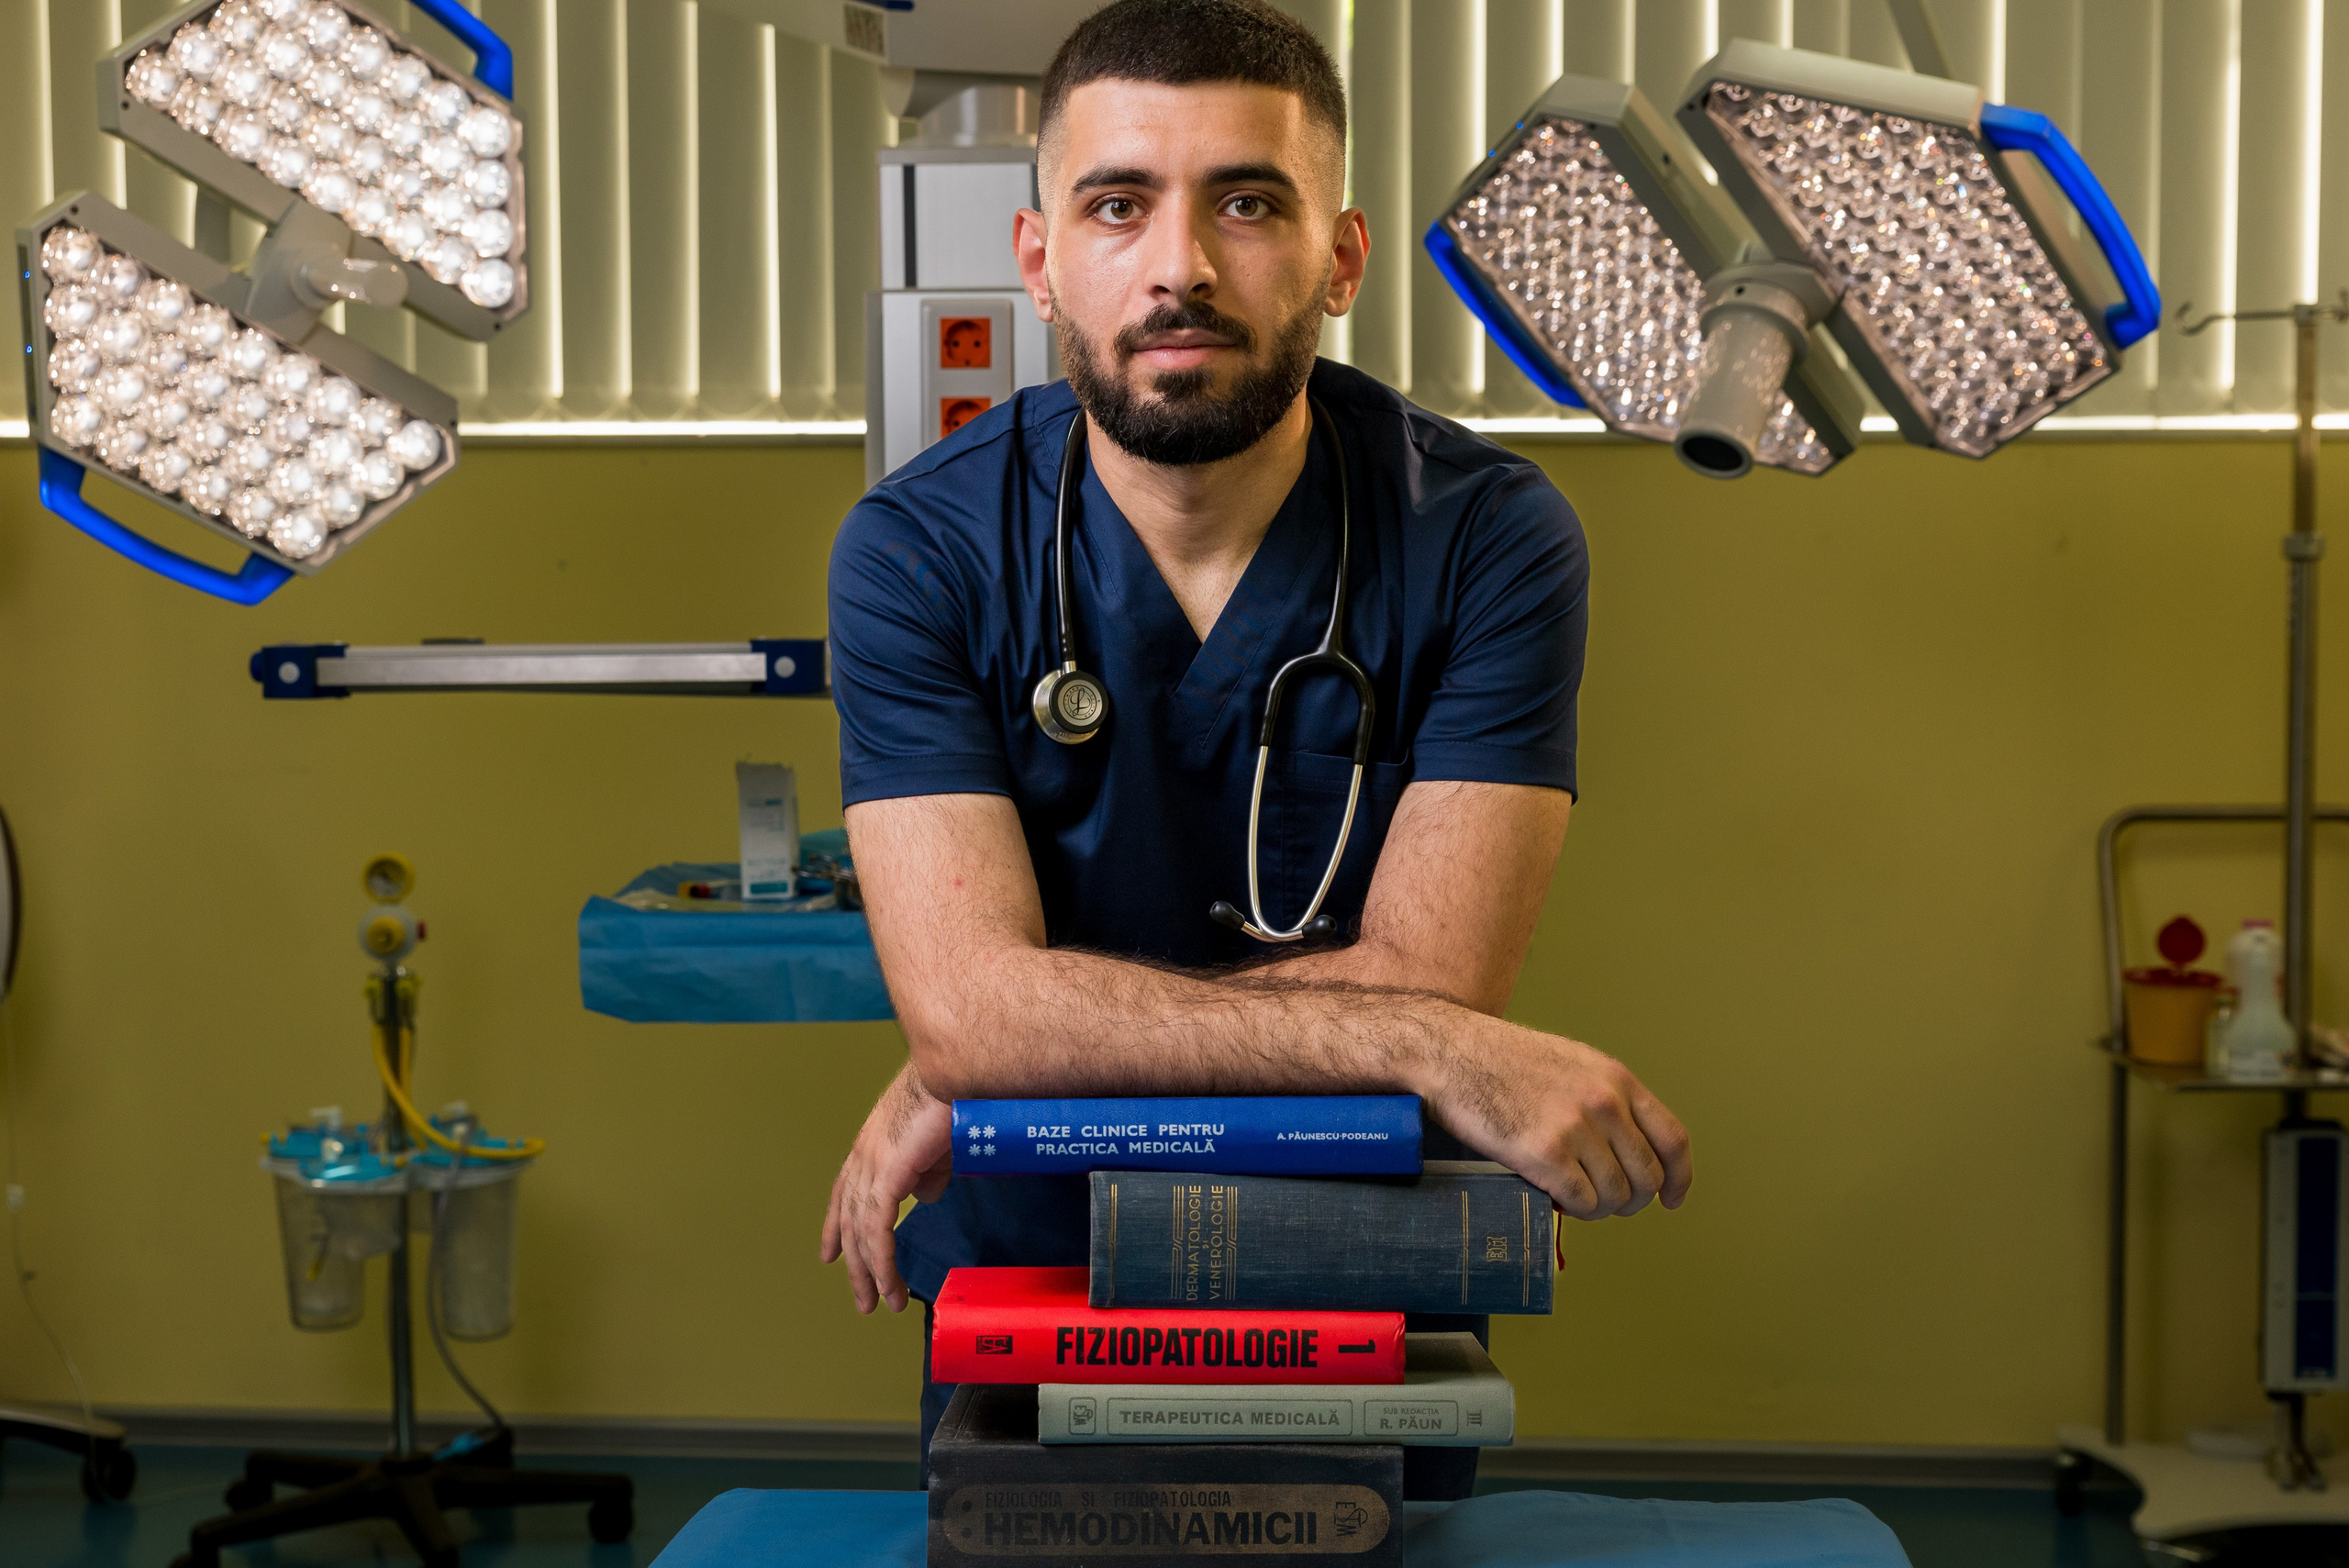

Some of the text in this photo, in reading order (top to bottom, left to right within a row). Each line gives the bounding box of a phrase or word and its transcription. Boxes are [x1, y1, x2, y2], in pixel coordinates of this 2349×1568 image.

[1027, 1124, 1225, 1138] BAZE CLINICE PENTRU
[1036, 1139, 1216, 1155] PRACTICA MEDICALĂ
[1186, 1185, 1201, 1301] DERMATOLOGIE
[1209, 1185, 1223, 1300] VENEROLOGIE
[1056, 1327, 1318, 1368] FIZIOPATOLOGIE
[1119, 1409, 1340, 1426] TERAPEUTICA MEDICALĂ
[1380, 1416, 1442, 1429] R. PĂUN
[985, 1493, 1063, 1508] FIZIOLOGIA
[1114, 1491, 1230, 1507] FIZIOPATOLOGIA
[984, 1511, 1317, 1546] HEMODINAMICII
